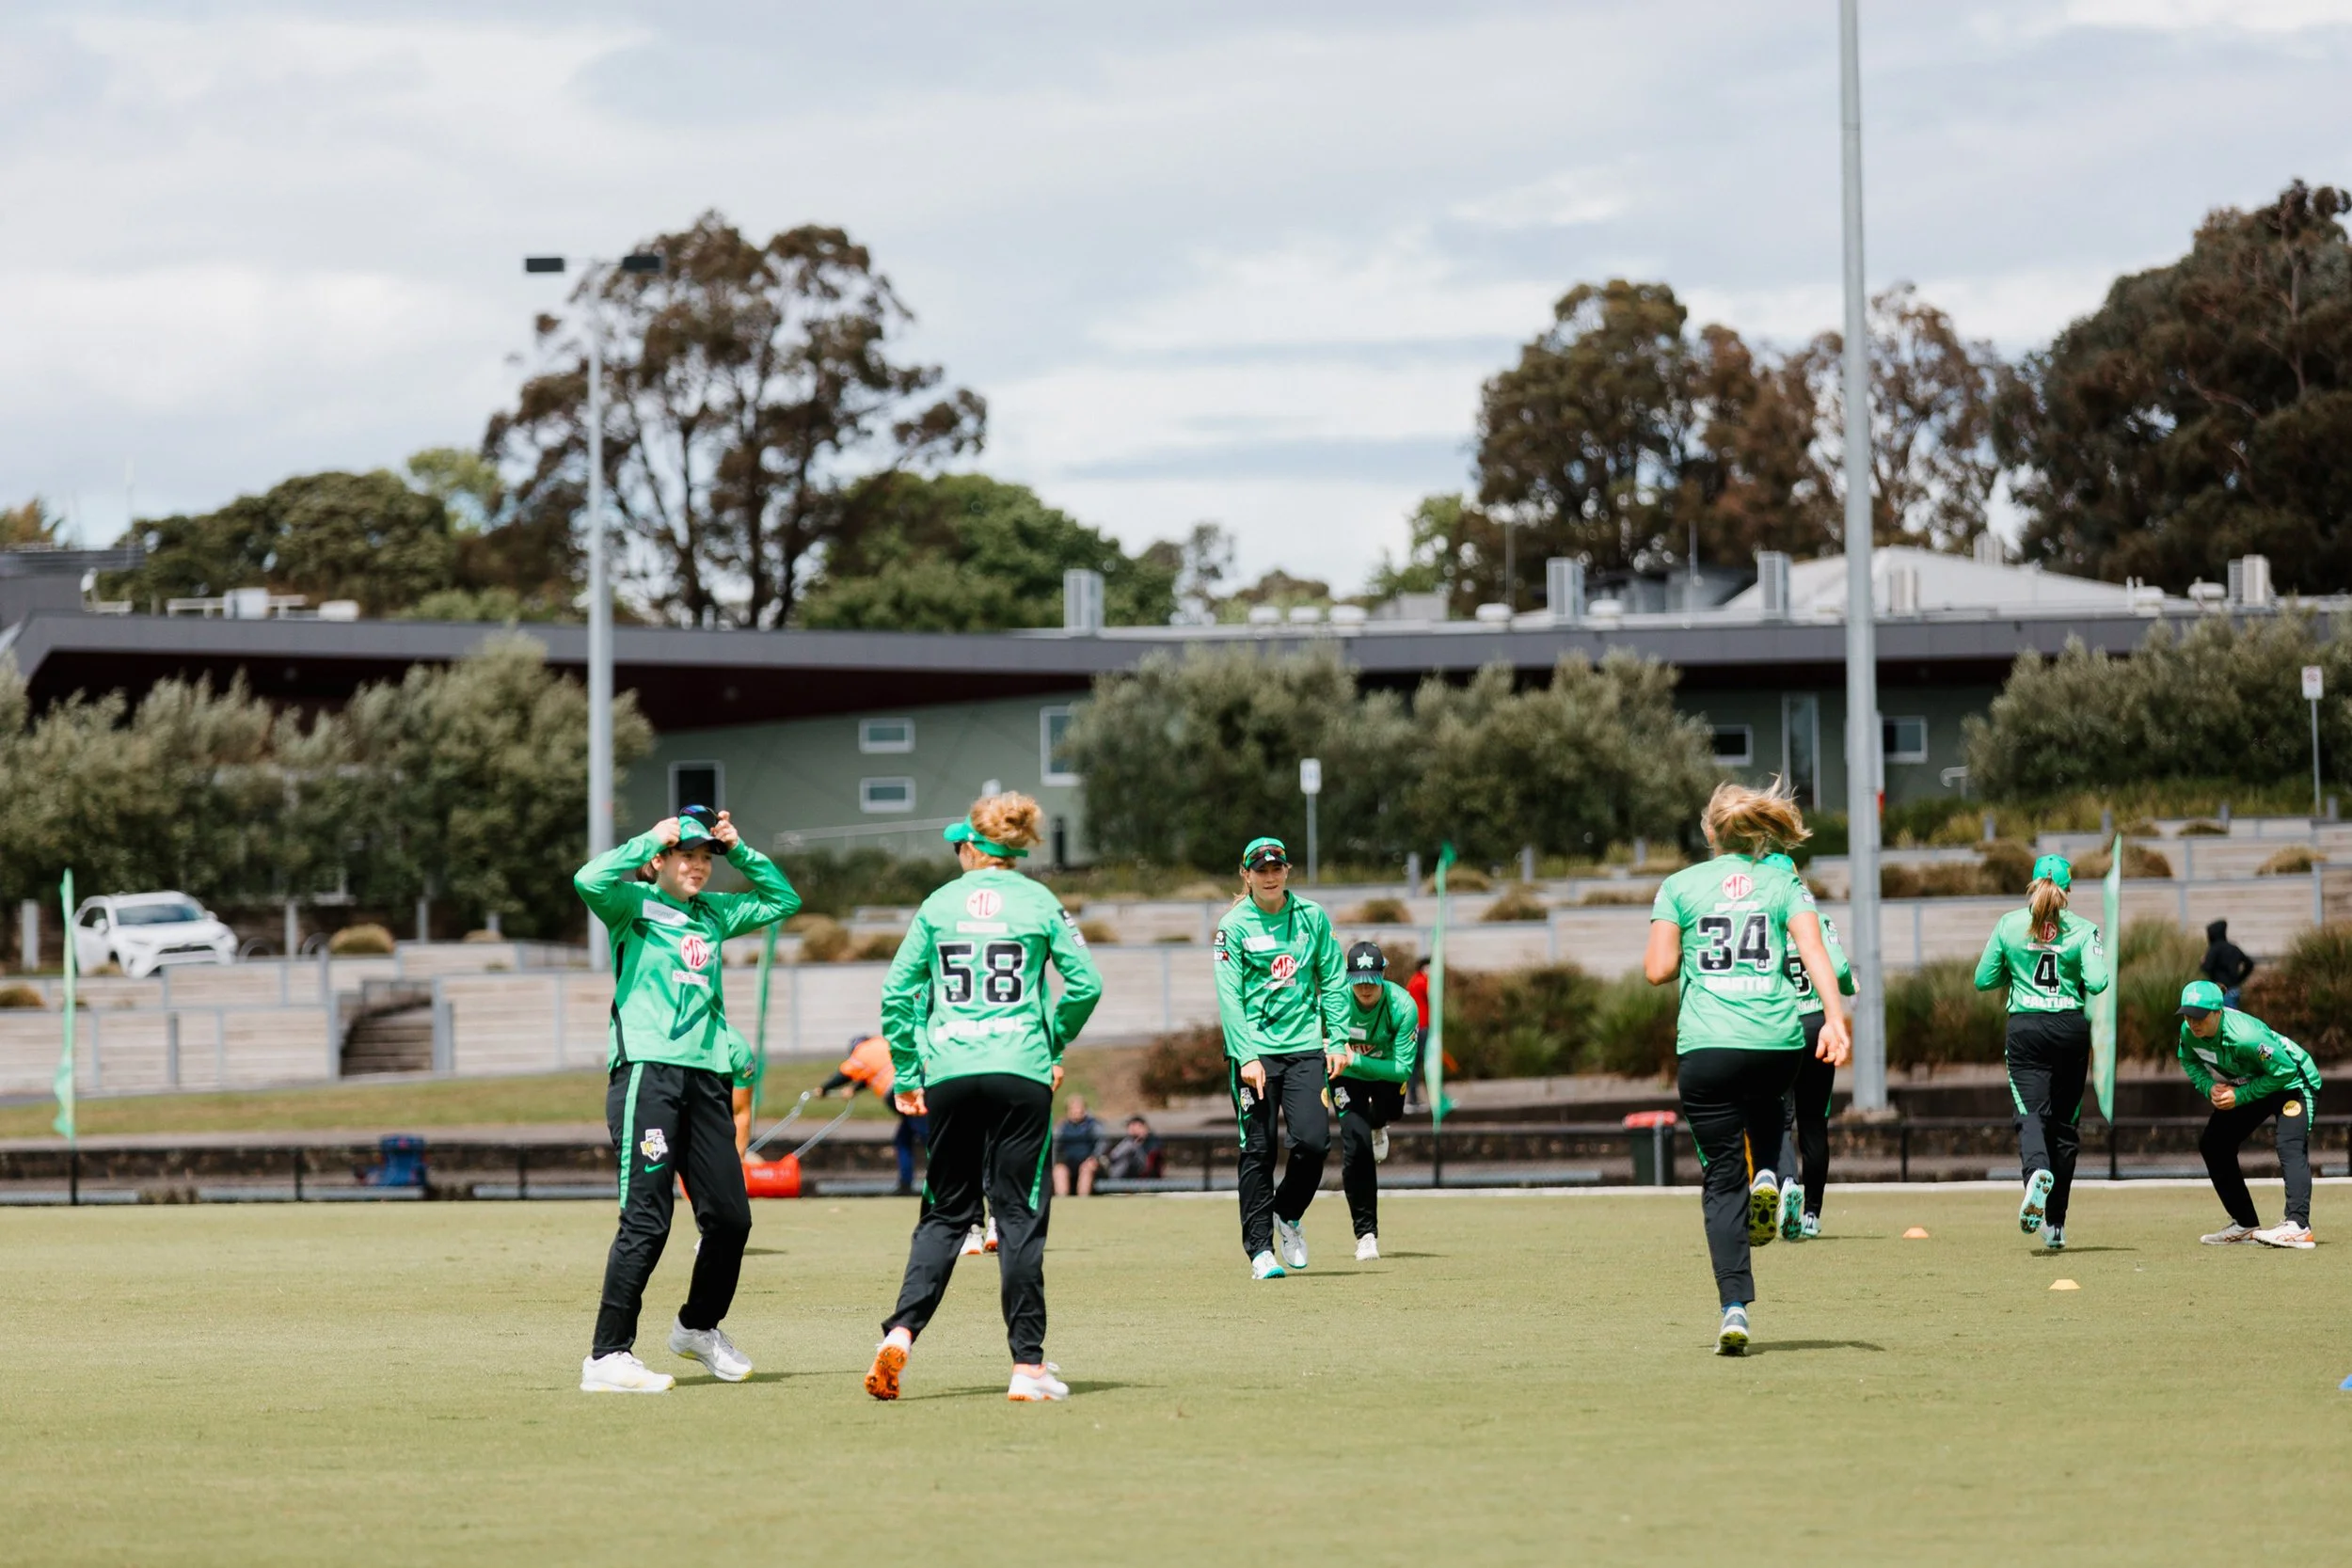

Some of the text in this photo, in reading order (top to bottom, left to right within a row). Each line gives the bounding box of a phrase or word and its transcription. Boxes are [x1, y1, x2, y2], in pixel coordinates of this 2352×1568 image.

[1697, 912, 1772, 973] 34
[936, 941, 1025, 1006] 58
[2032, 951, 2060, 996] 4
